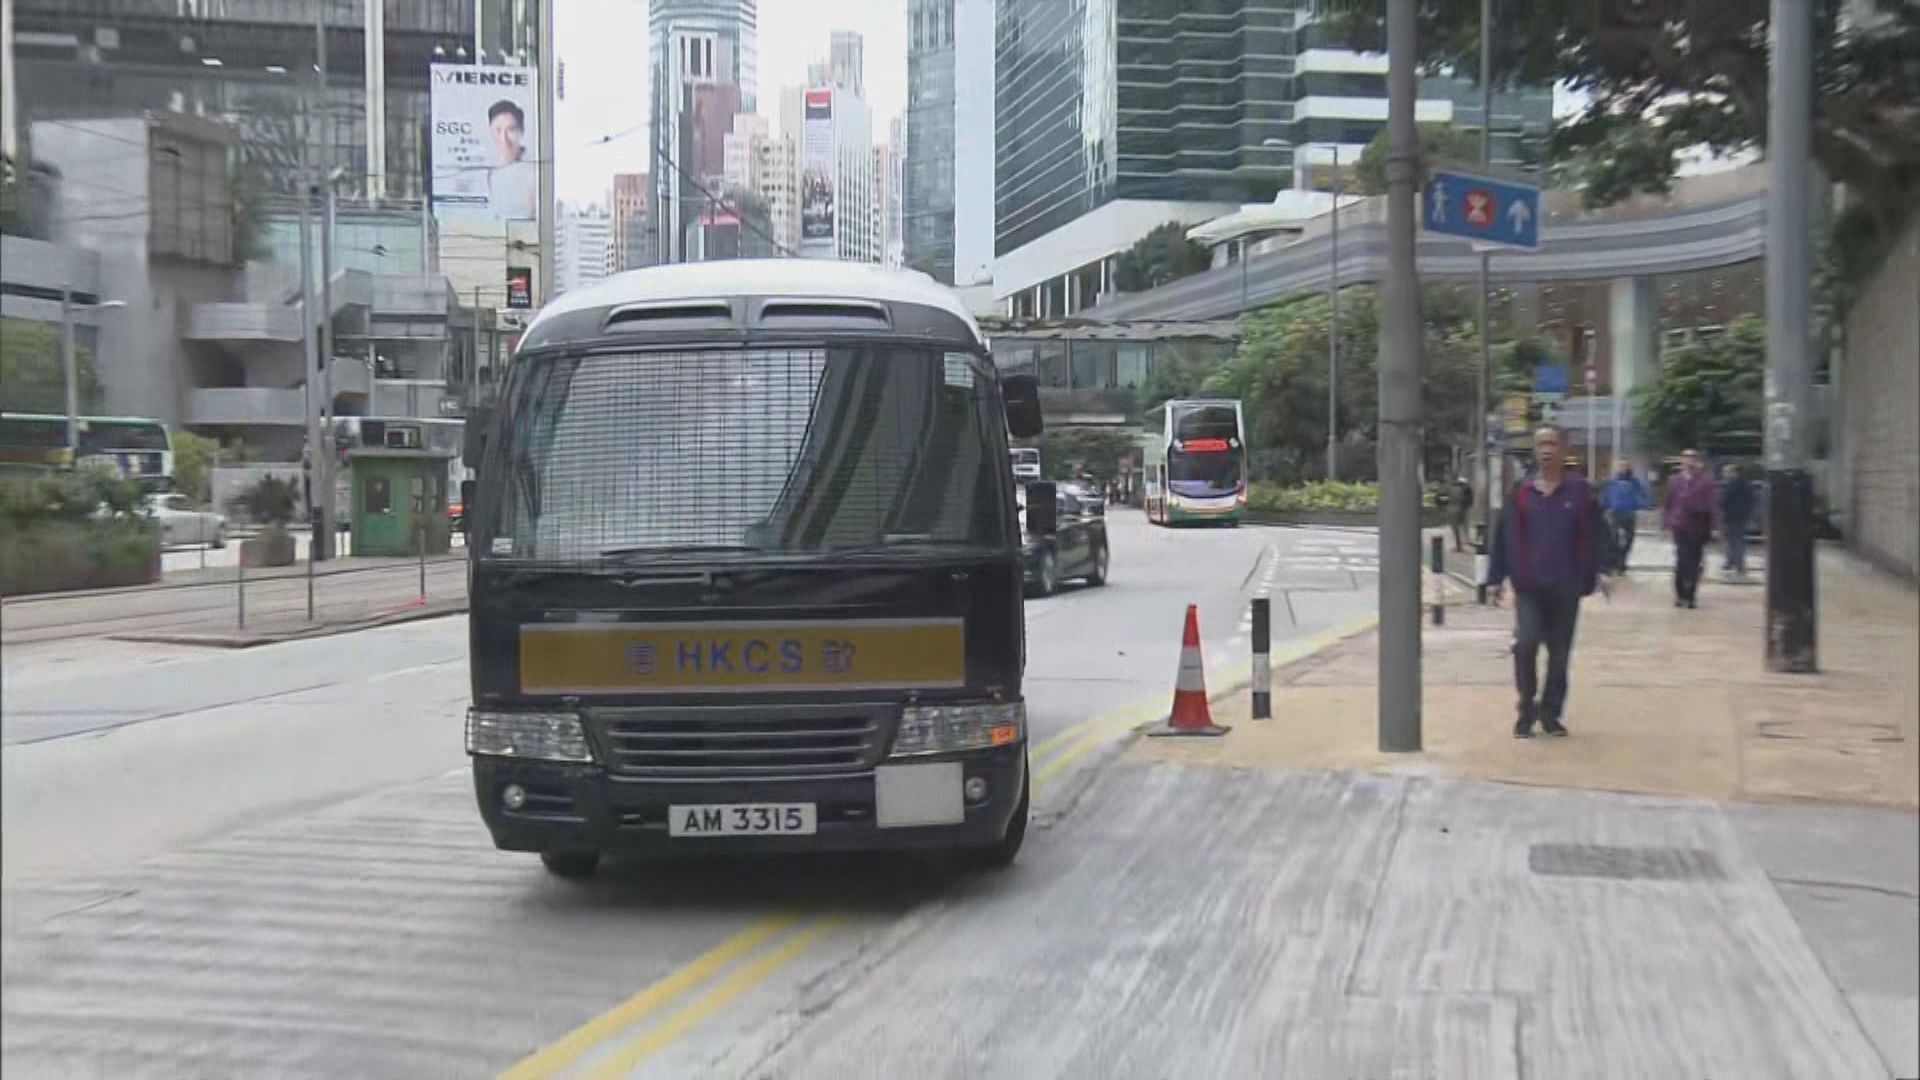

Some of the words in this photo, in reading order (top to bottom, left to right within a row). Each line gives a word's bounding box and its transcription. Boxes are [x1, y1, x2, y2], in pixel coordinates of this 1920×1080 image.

[436, 121, 472, 135] SGC
[676, 640, 804, 673] HKCS
[684, 808, 722, 832] AM
[732, 808, 803, 831] 3315
